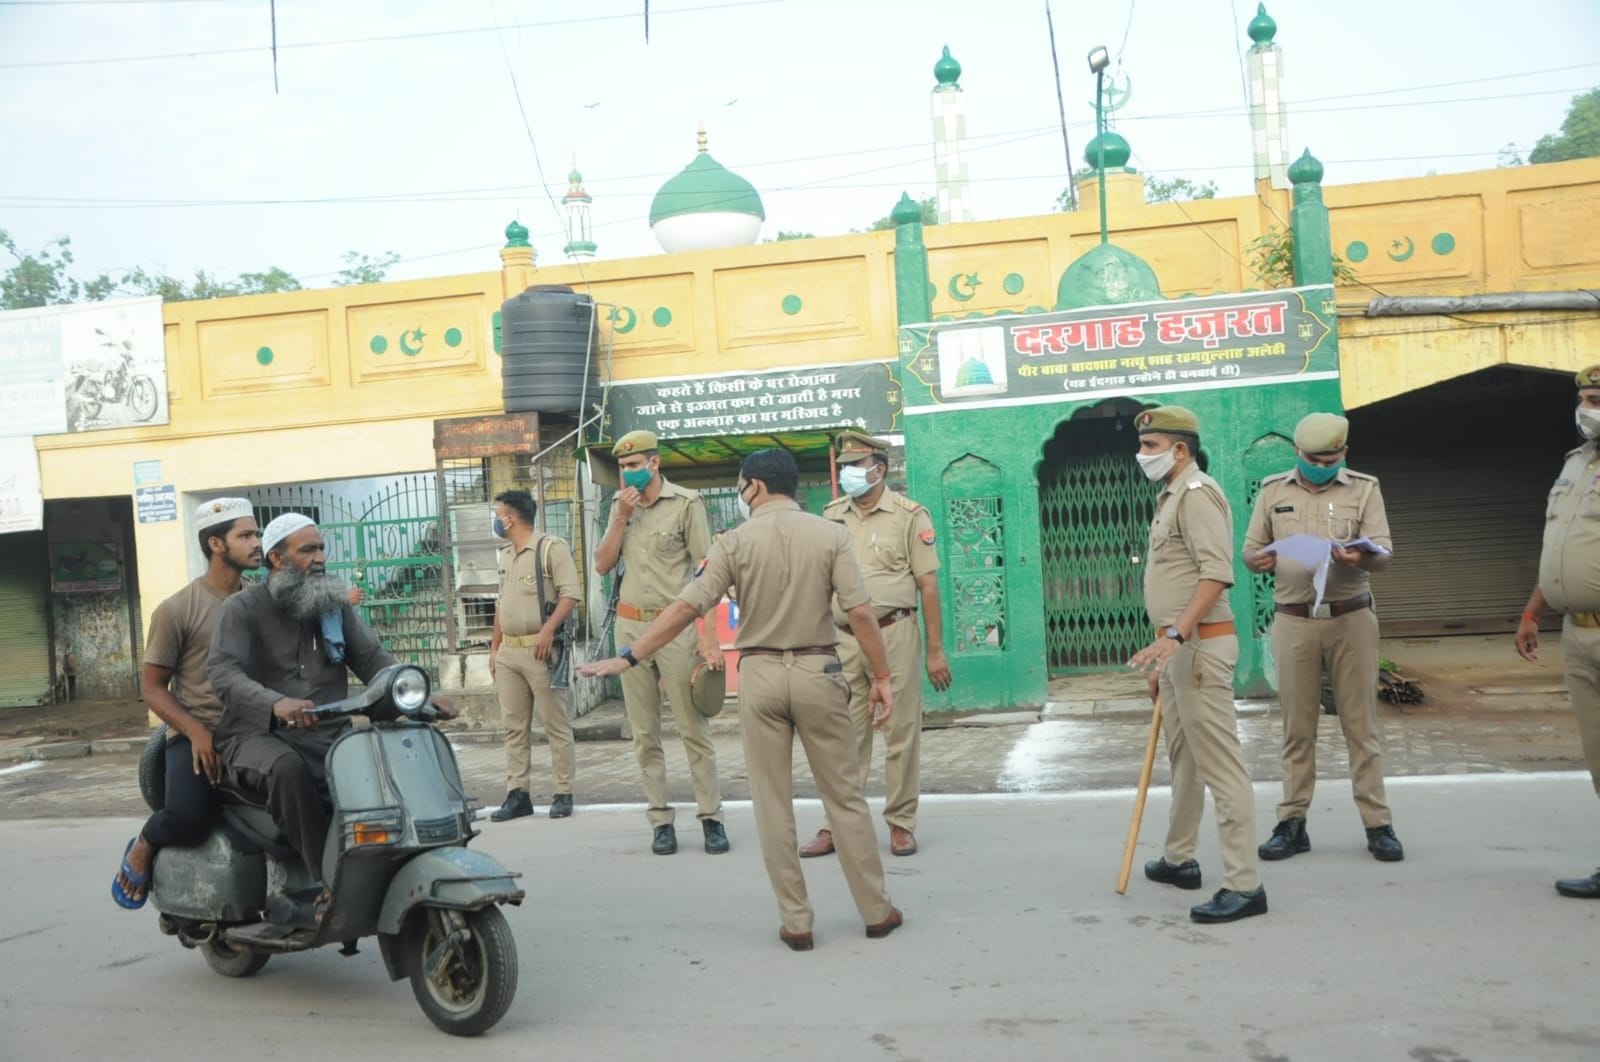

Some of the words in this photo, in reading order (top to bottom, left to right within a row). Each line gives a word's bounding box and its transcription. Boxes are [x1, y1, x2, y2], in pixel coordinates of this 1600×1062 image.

[1011, 314, 1149, 356] दरगाह
[1153, 301, 1288, 349] हज़रत
[1018, 364, 1039, 377] पीर
[1040, 363, 1068, 376] बाबा
[656, 384, 691, 398] कहते
[693, 381, 705, 395] हैं
[708, 378, 746, 394] किसी
[748, 377, 763, 391] के
[766, 377, 784, 389] घर
[787, 373, 837, 387] रोजाना
[635, 401, 667, 415] जाने
[669, 400, 683, 413] से
[685, 400, 728, 414] इज्जत
[730, 396, 756, 408] कम
[758, 392, 775, 406] हो
[776, 389, 814, 404] जाती
[816, 387, 828, 401] है
[830, 387, 861, 399] मगर
[656, 419, 681, 430] एक
[683, 415, 734, 428] अल्लाह
[737, 412, 758, 424] का
[760, 411, 778, 422] घर
[780, 406, 829, 420] मस्जिद
[830, 402, 843, 416] है
